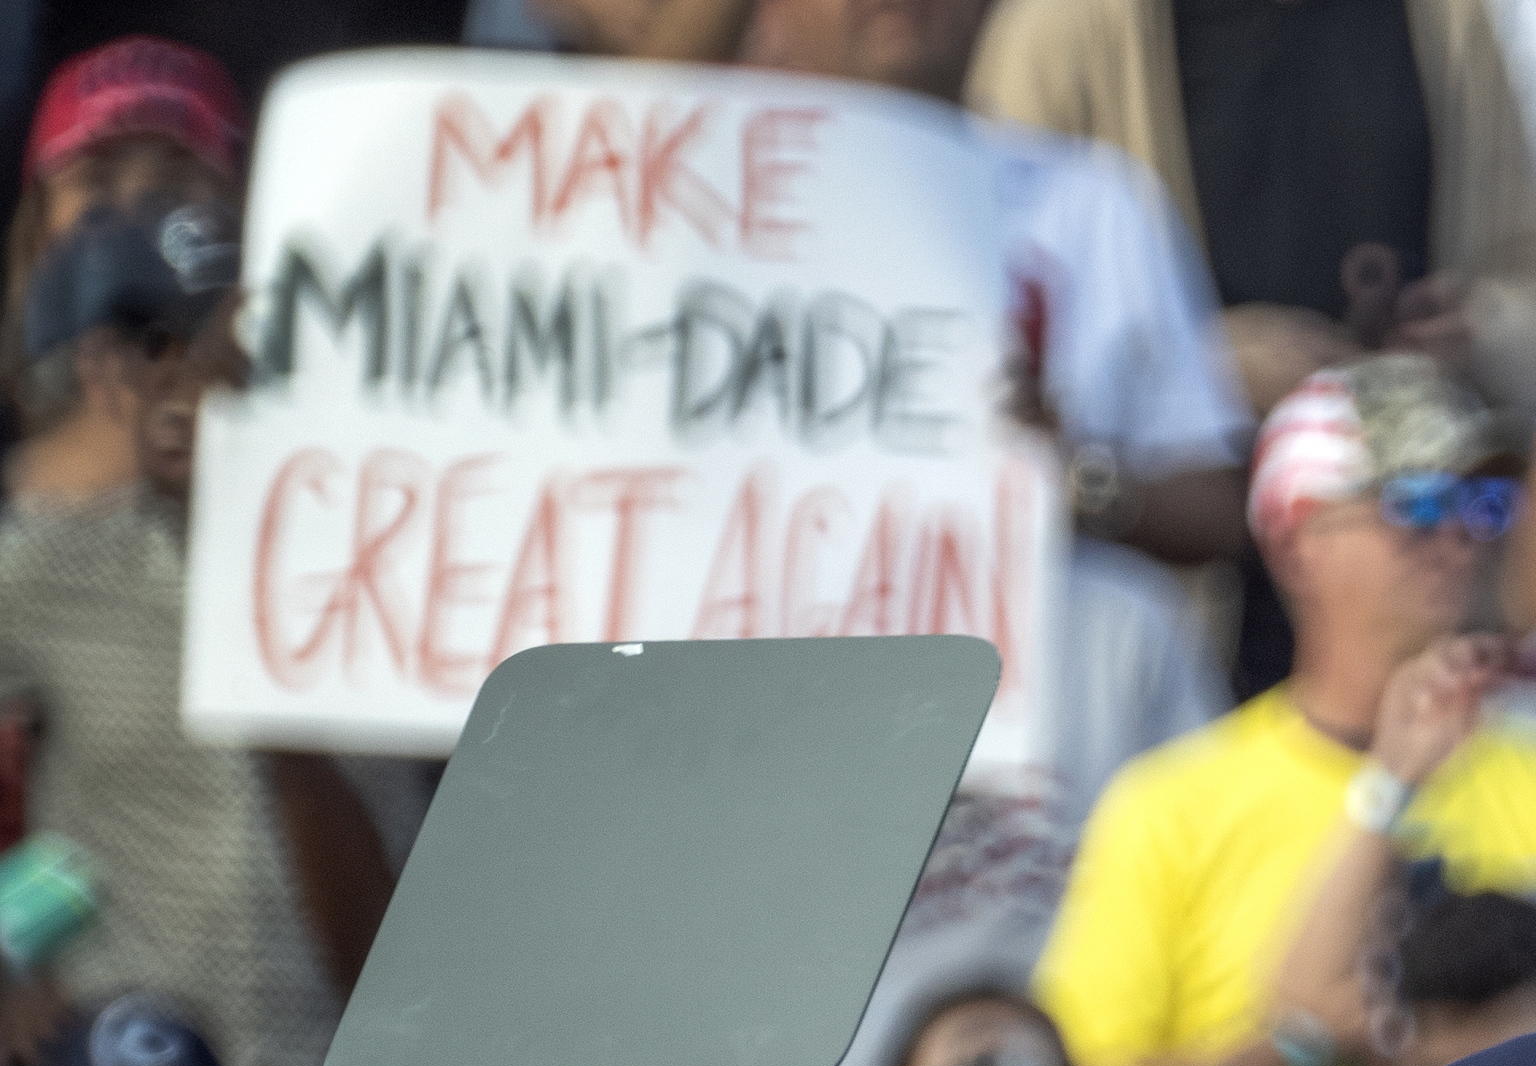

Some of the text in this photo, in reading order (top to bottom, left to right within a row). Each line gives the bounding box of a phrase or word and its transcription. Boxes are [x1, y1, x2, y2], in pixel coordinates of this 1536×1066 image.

[424, 92, 838, 260] MAKE
[252, 226, 972, 455] MIAMI-DADE
[252, 449, 1040, 698] GREAT AGAIN
